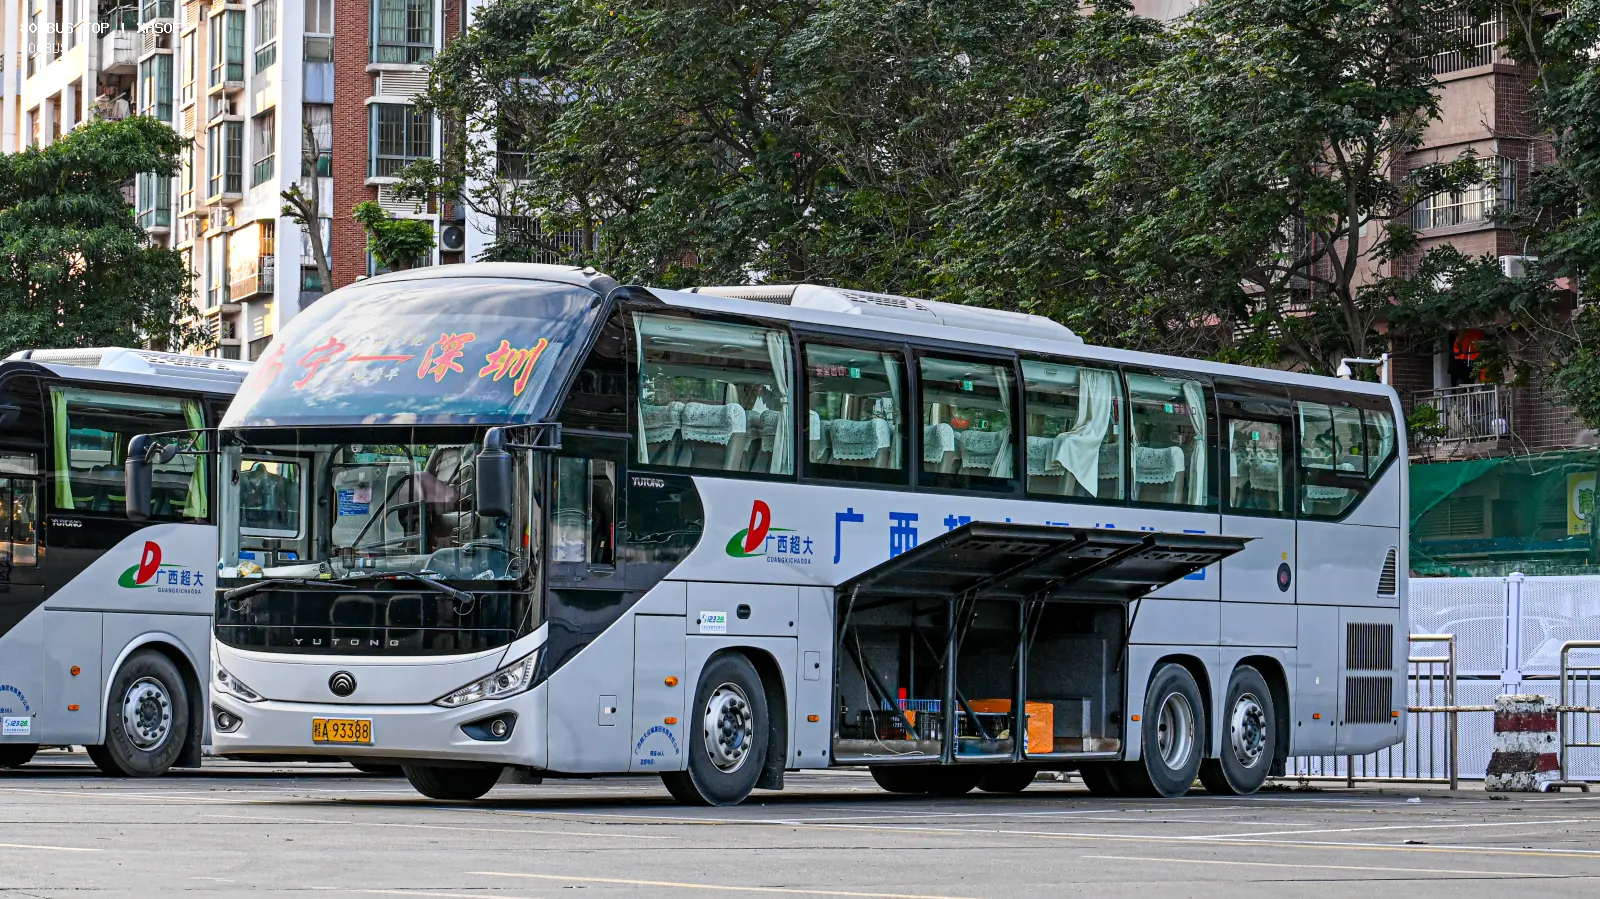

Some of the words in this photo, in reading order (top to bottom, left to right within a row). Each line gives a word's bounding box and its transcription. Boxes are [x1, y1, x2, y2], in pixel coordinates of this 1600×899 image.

[417, 332, 548, 396] 深圳
[631, 476, 665, 489] YUTONG
[50, 519, 83, 528] YUTONG
[764, 534, 814, 555] 广西超大
[155, 569, 204, 586] 广西超大
[295, 638, 399, 646] YUTONG
